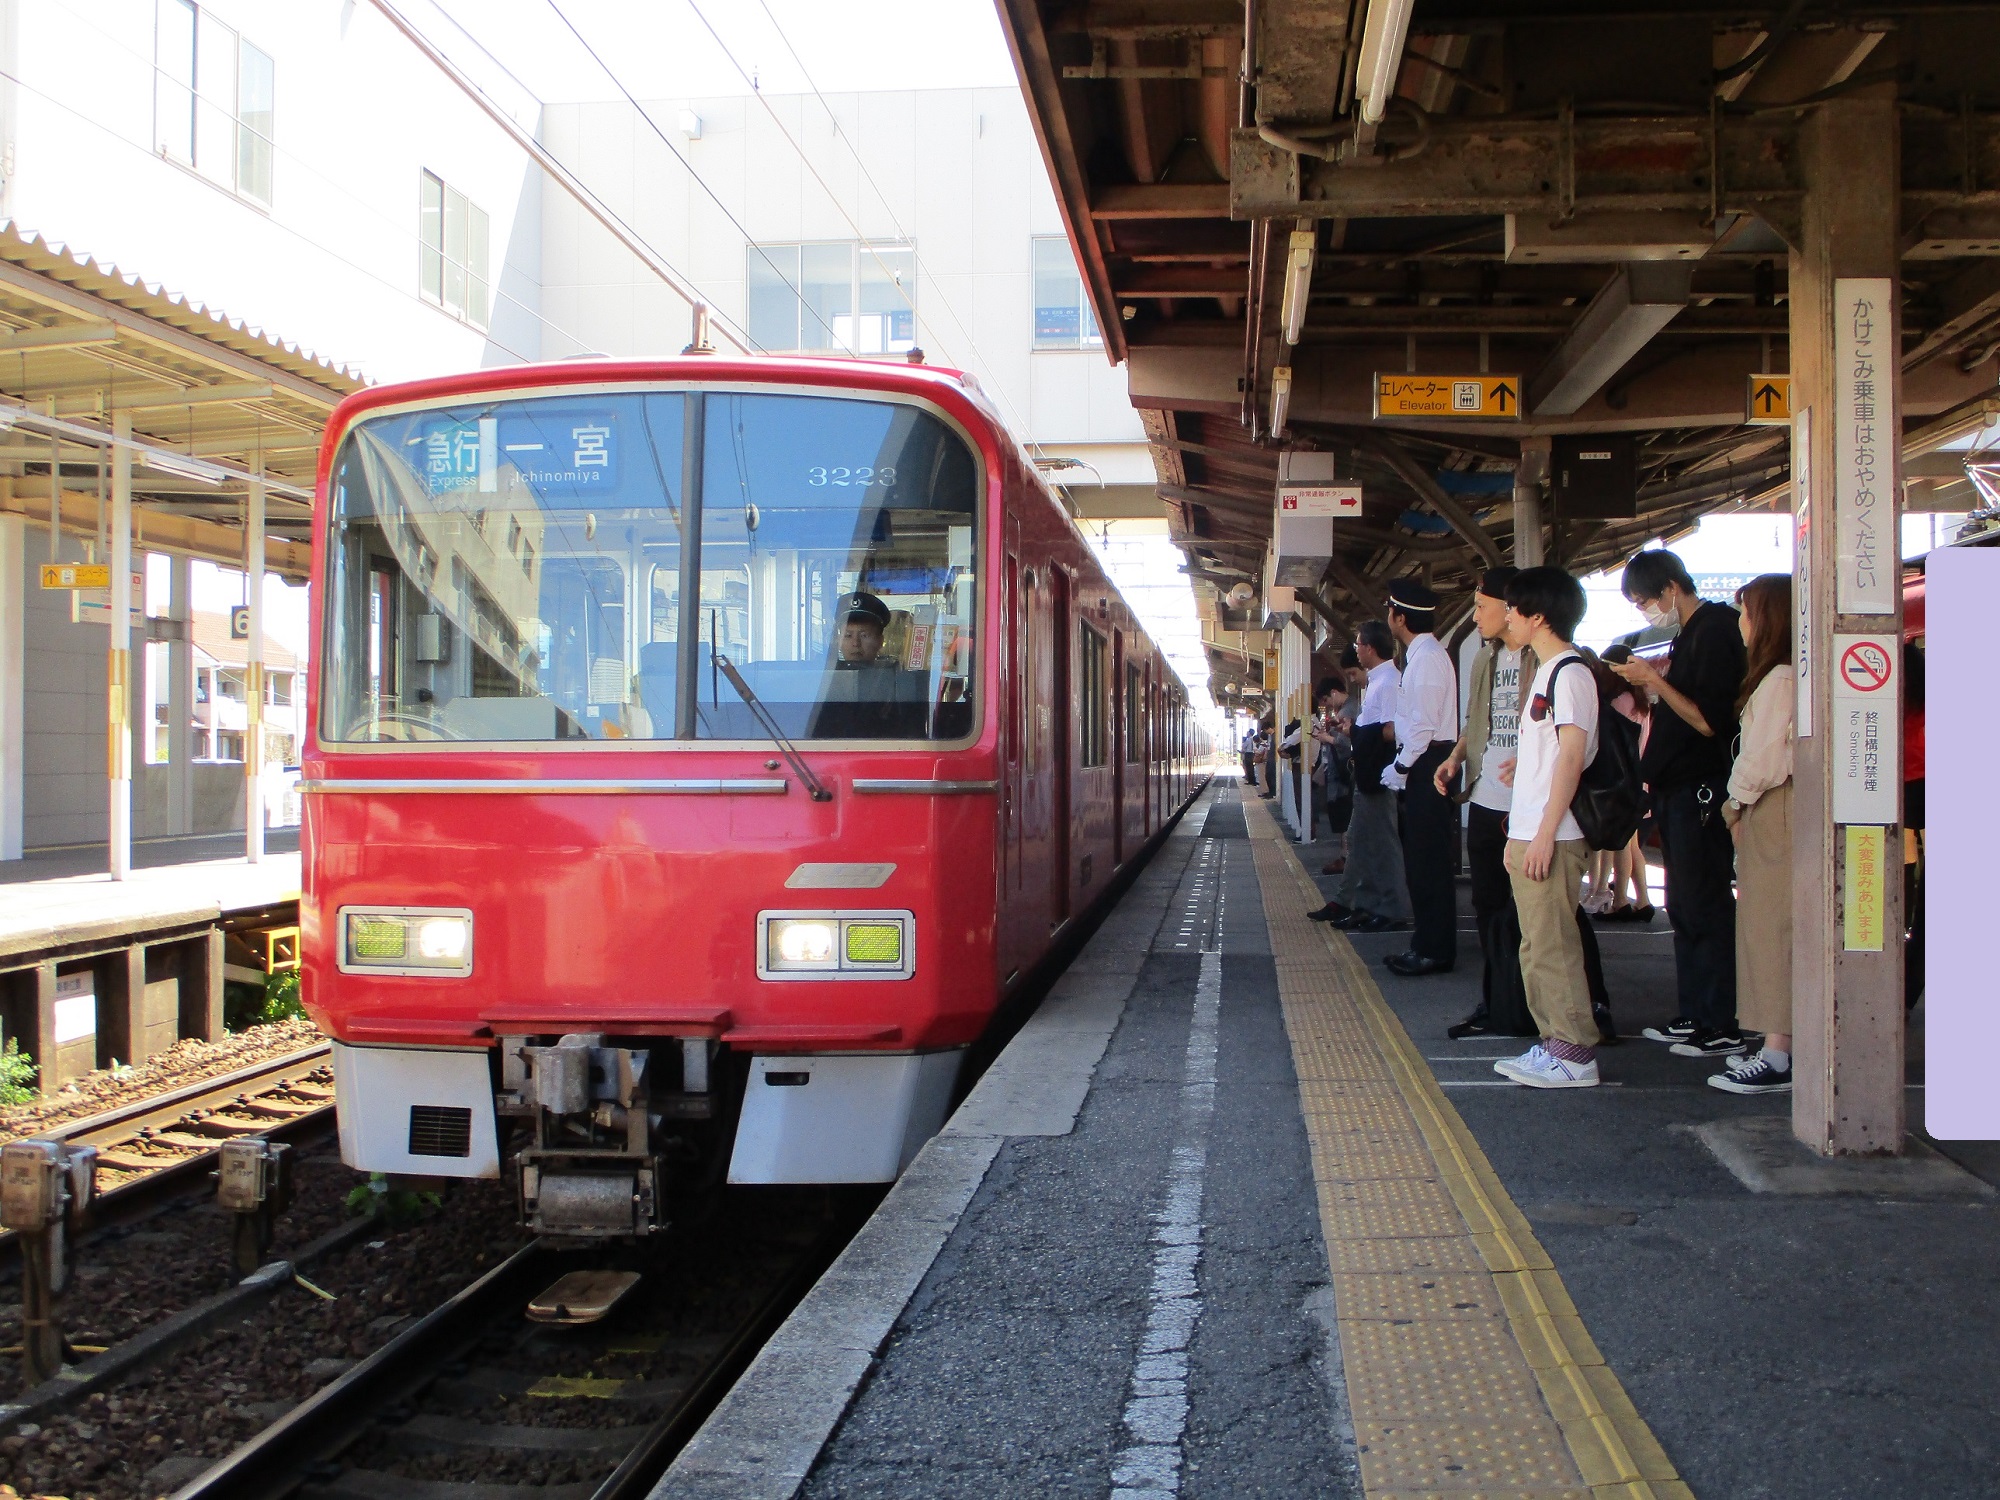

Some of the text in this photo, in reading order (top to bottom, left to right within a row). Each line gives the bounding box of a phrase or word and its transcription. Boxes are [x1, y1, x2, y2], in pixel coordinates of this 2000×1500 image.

[1380, 382, 1448, 397] エレベーター
[1400, 400, 1447, 410] Elevator
[427, 431, 479, 473] 急行
[506, 424, 610, 467] 一宮
[1853, 298, 1877, 589] かけこみ乗車はおやめください
[429, 475, 477, 487] Express
[516, 469, 600, 483] Ichinomiya
[808, 466, 897, 486] 3223
[234, 609, 249, 635] 6
[1848, 711, 1860, 778] No Smoking
[1864, 711, 1878, 792] 終日構内禁煙
[1857, 834, 1875, 948] 大変混みあいます。
